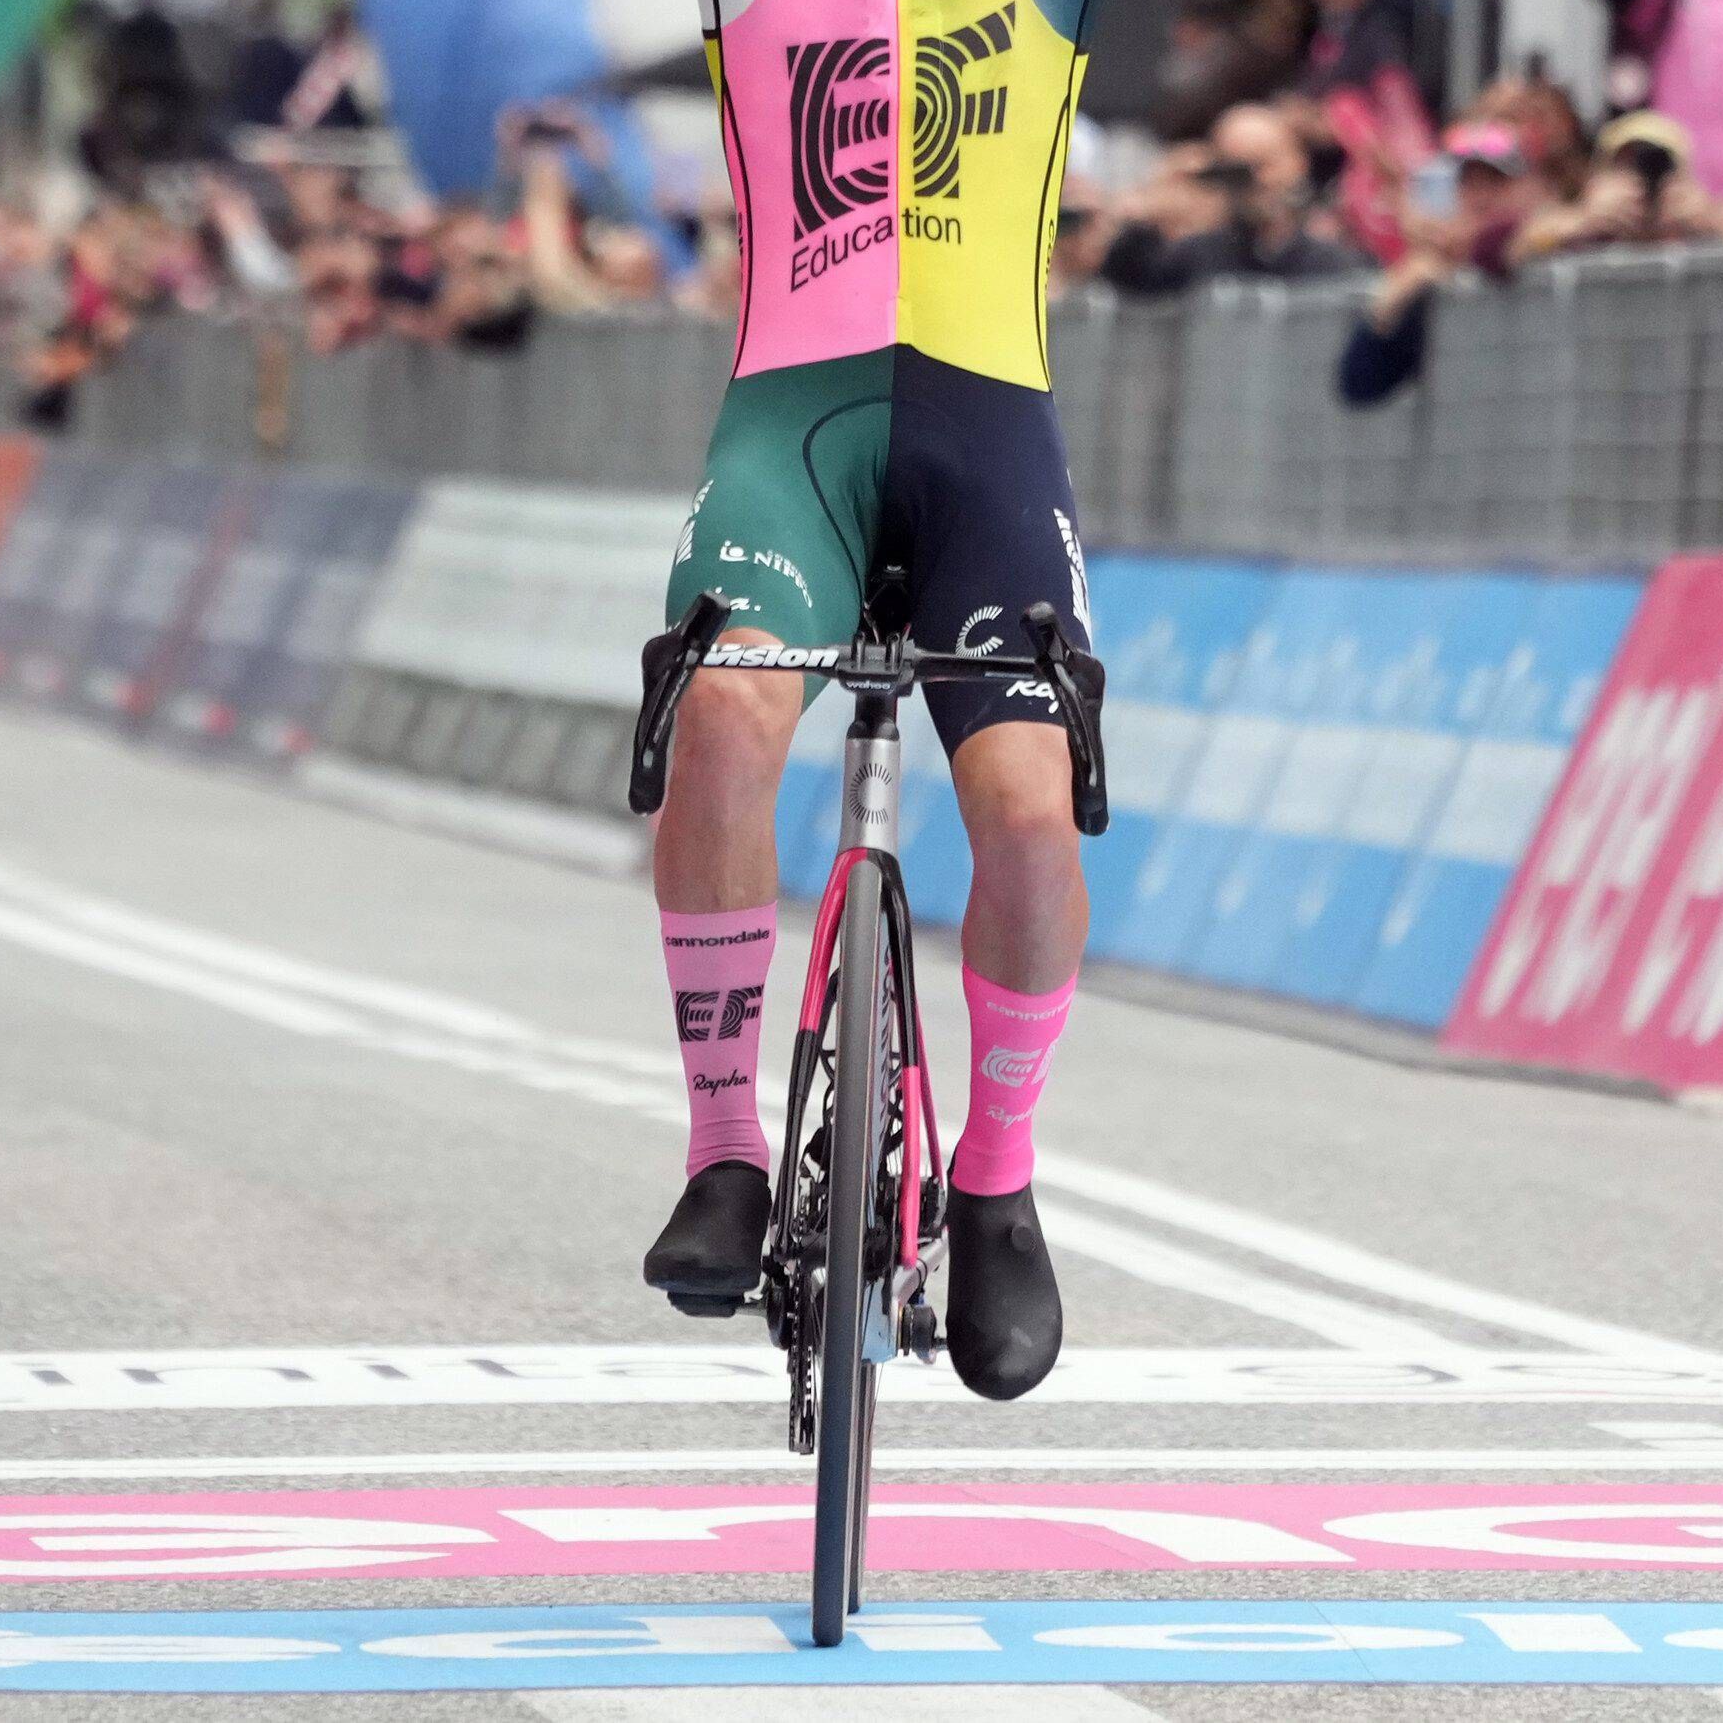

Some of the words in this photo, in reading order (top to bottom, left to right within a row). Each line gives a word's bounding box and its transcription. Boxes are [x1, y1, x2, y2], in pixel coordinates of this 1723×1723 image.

[790, 206, 962, 293] Education
[845, 680, 891, 690] wahoo
[665, 928, 770, 948] cannondale
[676, 984, 765, 1042] EF
